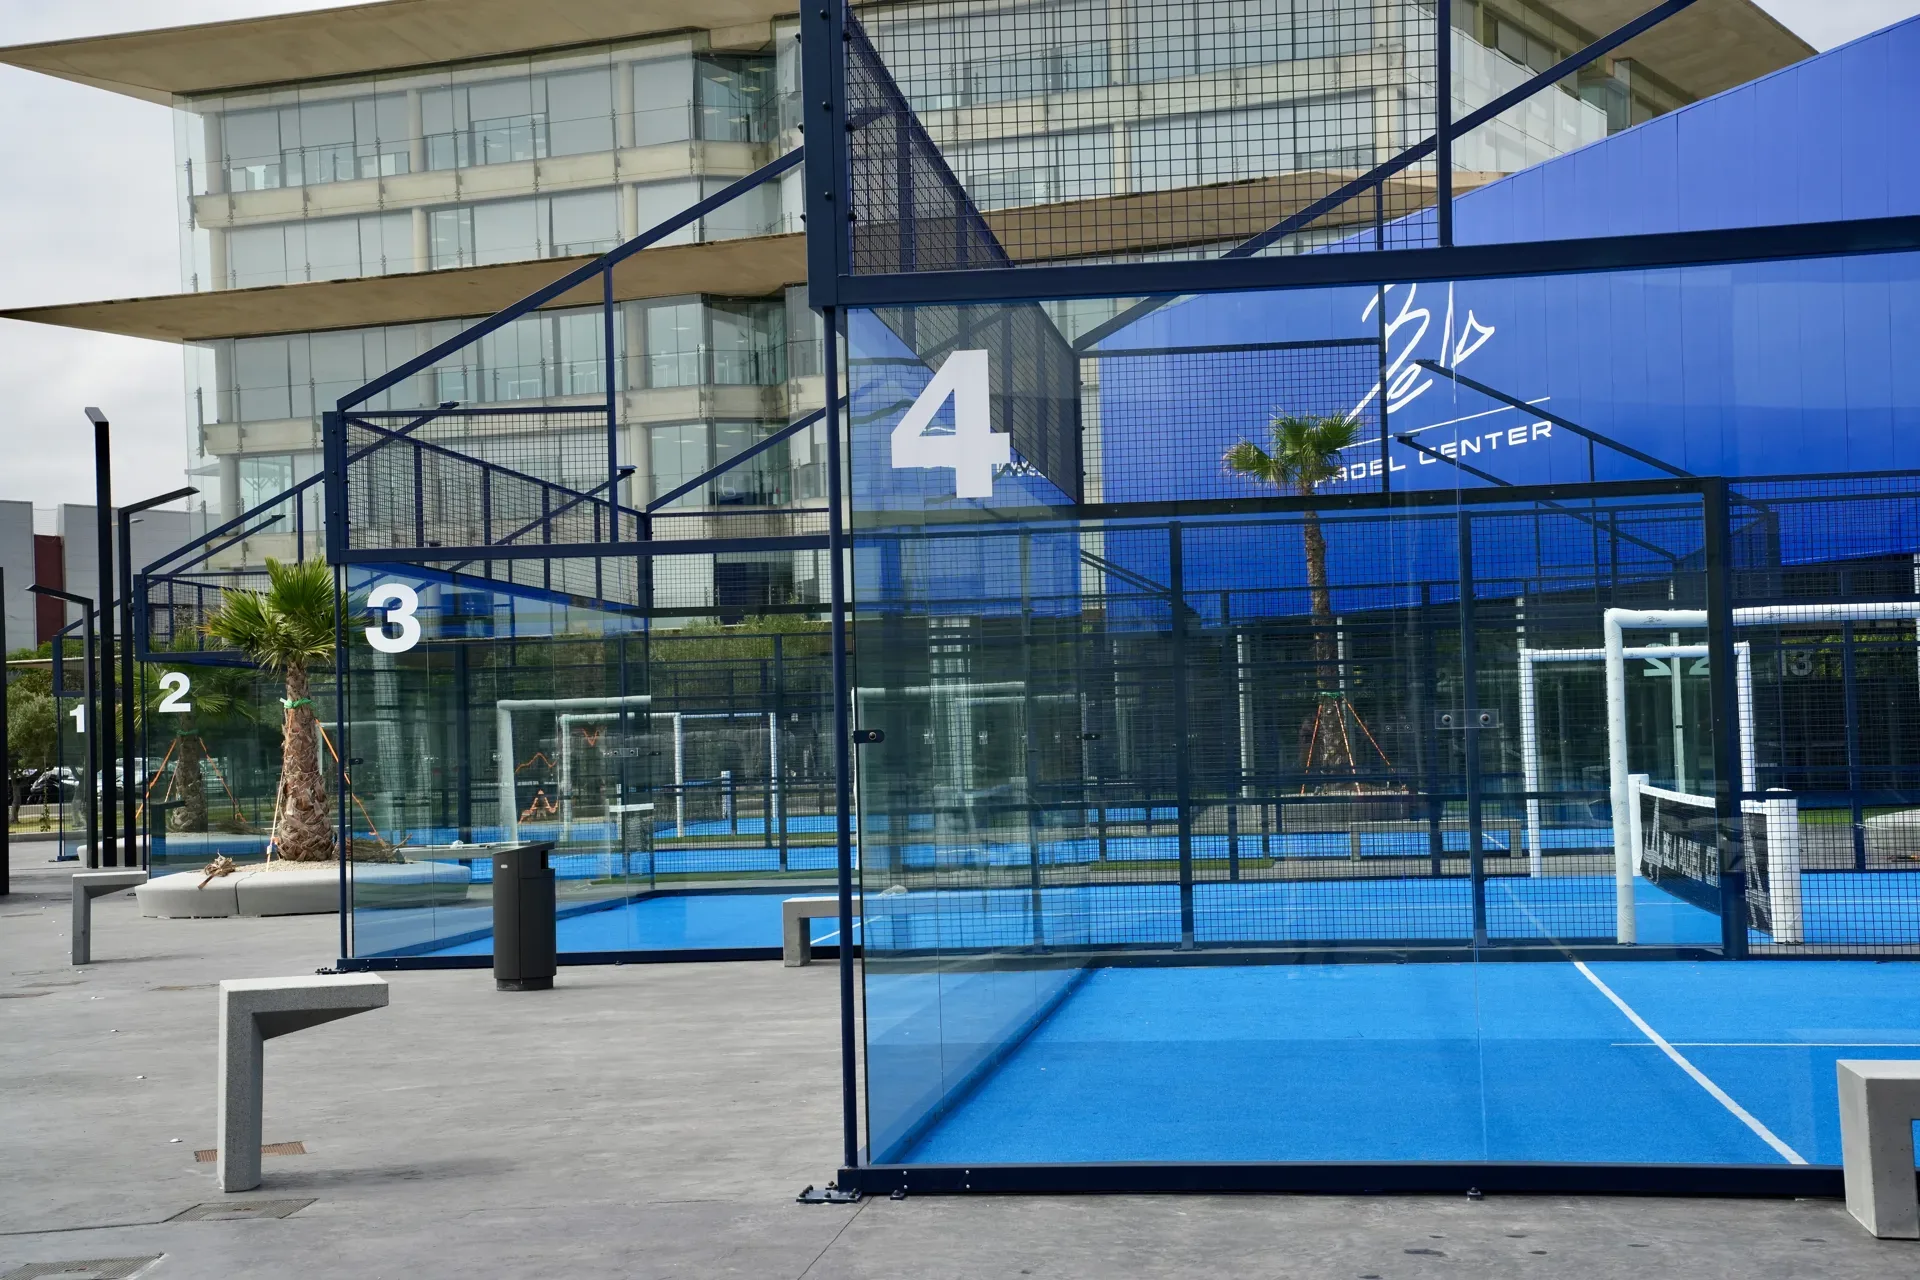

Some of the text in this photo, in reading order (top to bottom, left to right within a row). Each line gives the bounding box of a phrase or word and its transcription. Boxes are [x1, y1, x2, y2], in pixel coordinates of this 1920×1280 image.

[891, 349, 1010, 498] 4
[1419, 420, 1552, 465] CENTER
[365, 583, 421, 653] 3
[158, 672, 191, 713] 2
[70, 704, 85, 733] 1
